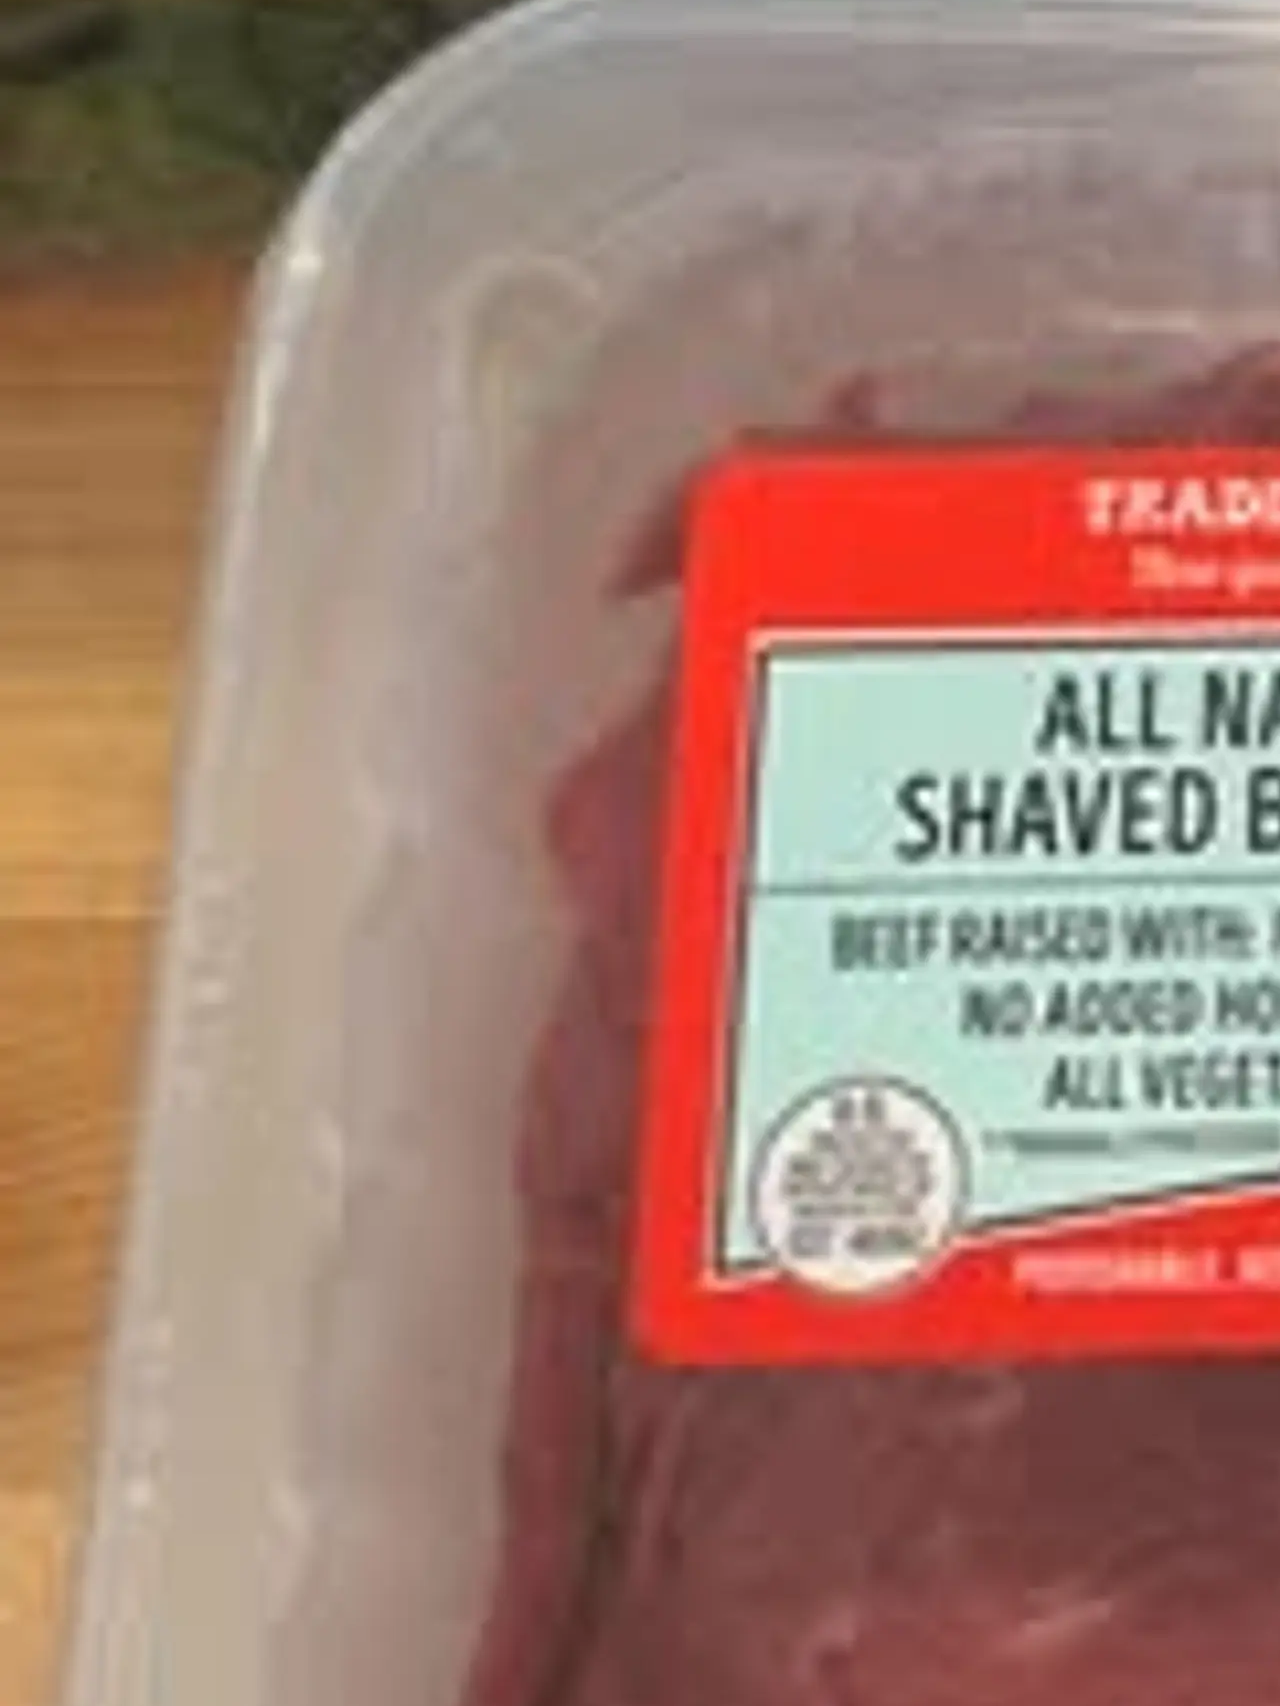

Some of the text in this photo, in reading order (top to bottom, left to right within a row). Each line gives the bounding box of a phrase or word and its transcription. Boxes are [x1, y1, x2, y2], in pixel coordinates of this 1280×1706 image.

[1036, 675, 1175, 752] ALL
[895, 768, 1215, 863] SHAVED
[832, 909, 937, 971] BEEF
[951, 908, 1110, 964] RAISED
[960, 984, 1034, 1038] NO
[1043, 980, 1205, 1036] ADDED
[1046, 1052, 1134, 1112] ALL
